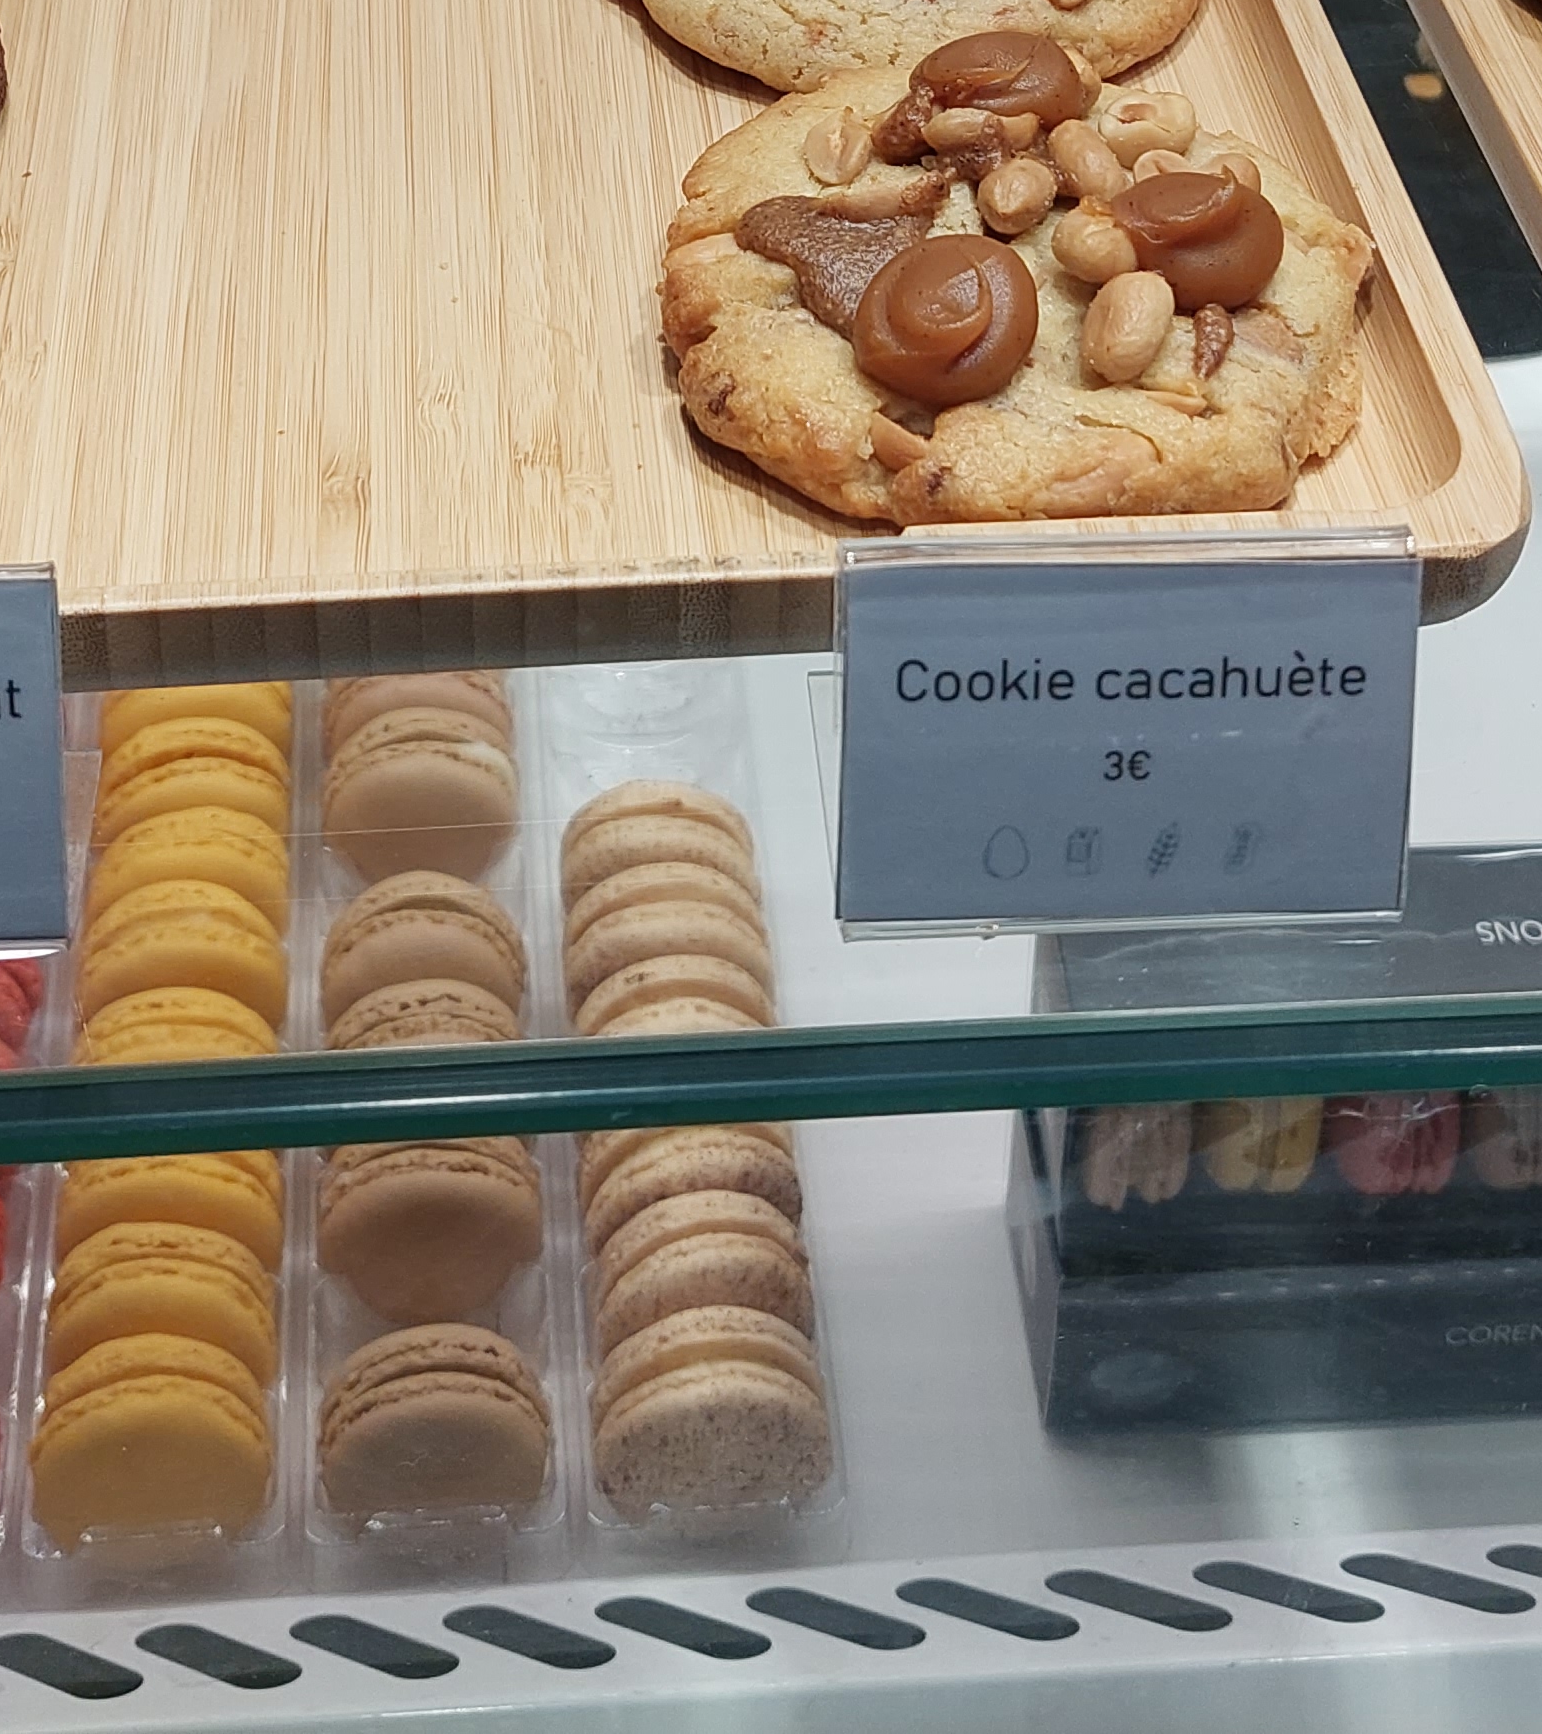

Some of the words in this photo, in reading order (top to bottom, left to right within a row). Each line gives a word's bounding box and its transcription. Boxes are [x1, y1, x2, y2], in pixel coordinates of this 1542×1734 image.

[895, 658, 1076, 703] Cookie
[1095, 649, 1368, 701] cacahuète
[1102, 749, 1153, 782] 3€
